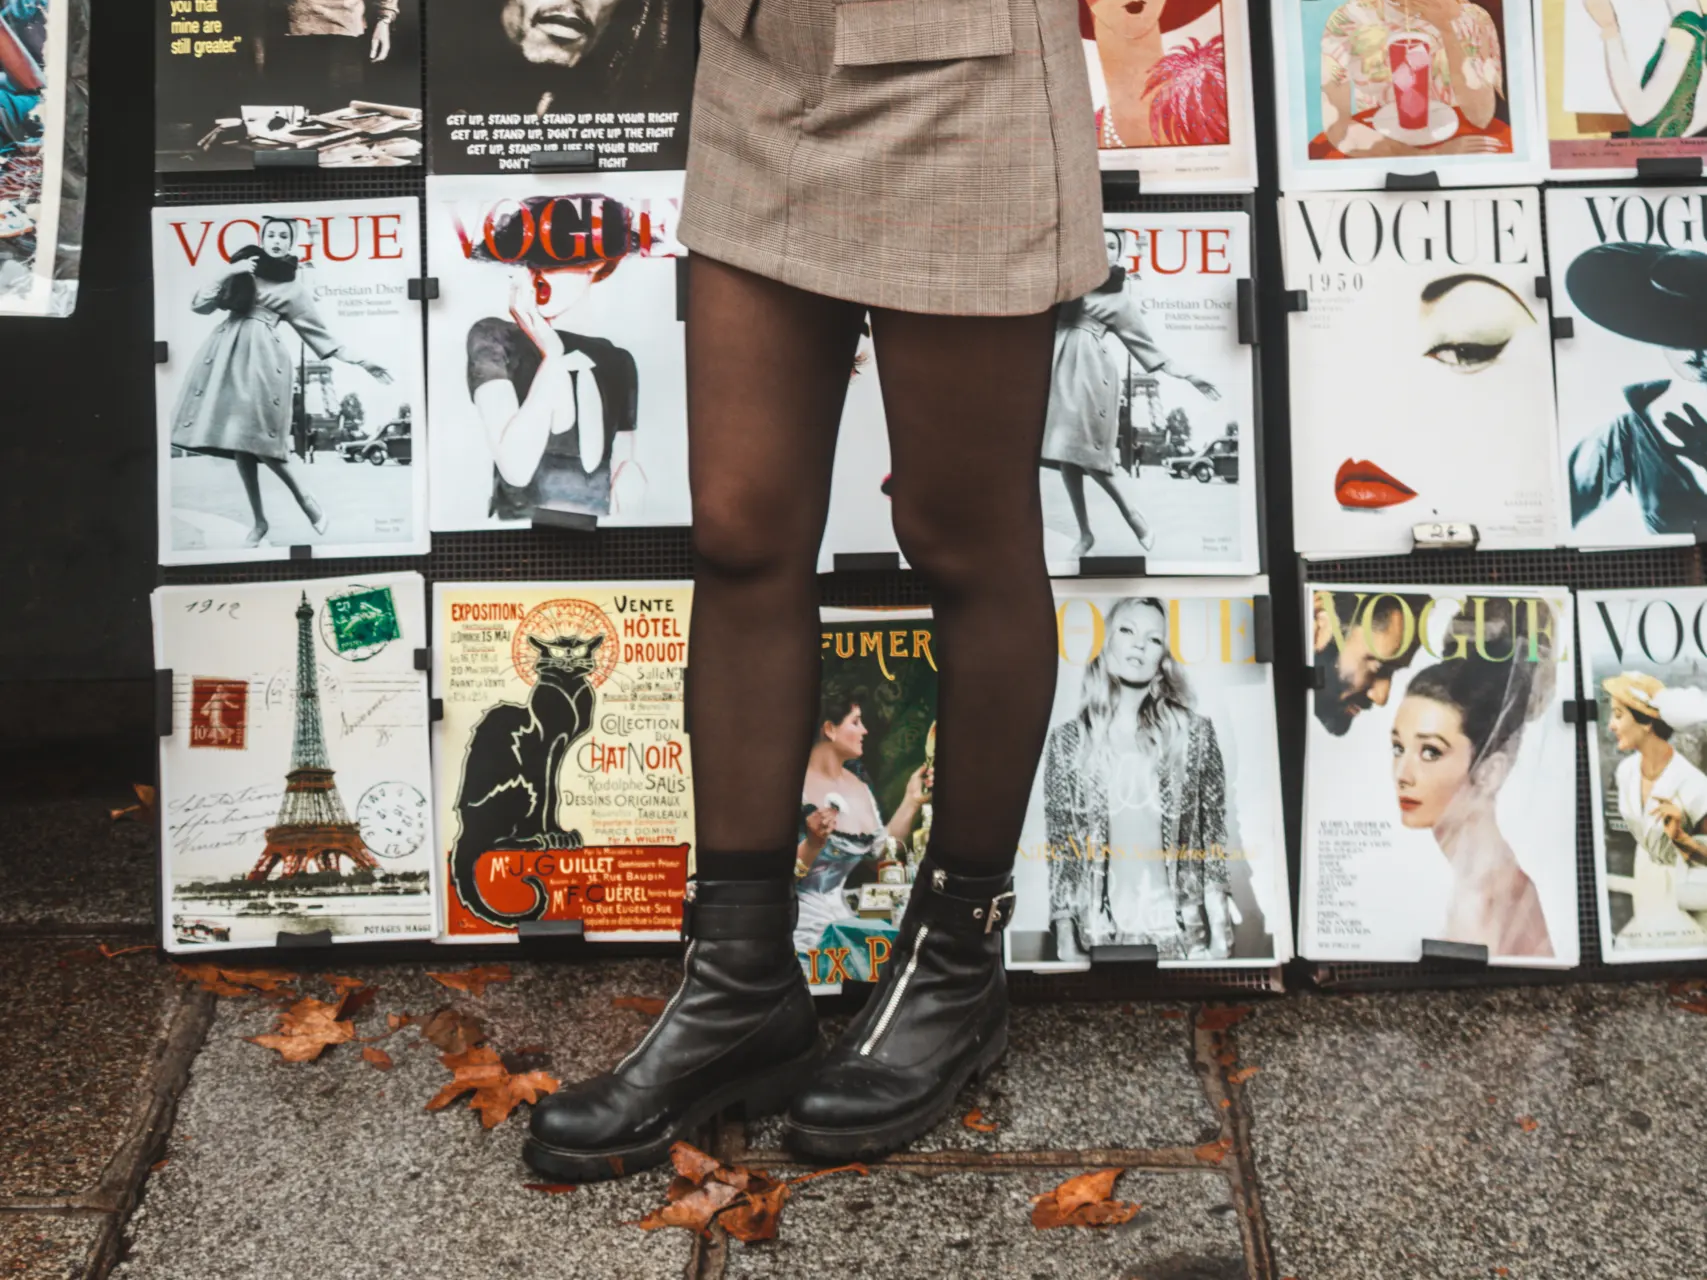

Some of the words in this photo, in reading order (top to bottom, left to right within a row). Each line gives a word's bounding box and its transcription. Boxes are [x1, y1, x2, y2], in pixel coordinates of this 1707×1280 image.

[170, 0, 192, 16] you
[171, 17, 199, 33] mine
[203, 20, 222, 33] are
[171, 37, 191, 54] still
[446, 115, 467, 126] GET
[487, 114, 521, 125] STAND
[542, 113, 576, 125] STAND
[577, 113, 593, 124] UP
[595, 112, 615, 124] FOR
[617, 112, 645, 123] YOUR
[647, 111, 680, 123] RIGHT
[450, 129, 471, 140] GET
[492, 128, 526, 140] STAND
[547, 126, 578, 140] DON'T
[580, 127, 605, 139] GIVE
[606, 127, 622, 139] UP
[624, 127, 645, 139] THE
[646, 126, 675, 138] FIGHT
[466, 143, 487, 155] GET
[597, 142, 626, 153] YOUR
[627, 141, 660, 153] RIGHT
[498, 158, 530, 170] DON'T
[598, 157, 628, 169] FIGHT
[443, 197, 685, 262] VOGUE
[1584, 193, 1707, 248] VOG
[1297, 198, 1529, 267] VOGUE
[314, 283, 372, 297] Christian
[376, 282, 405, 295] Dior
[1309, 272, 1363, 293] 1950
[1141, 298, 1200, 310] Christian
[1203, 298, 1232, 309] Dior
[184, 598, 241, 620] 1912
[452, 603, 525, 621] EXPOSITIONS
[614, 595, 675, 614] VENTE
[624, 614, 681, 638] HÔTEL
[1314, 591, 1568, 663] VOGUE
[624, 642, 685, 663] DROUOT
[600, 713, 680, 737] COLLECTION
[564, 790, 612, 806] DESSINS
[614, 794, 681, 808] ORIGINAUX
[638, 808, 689, 819] TABLEAUX
[625, 872, 667, 882] BAUDIN
